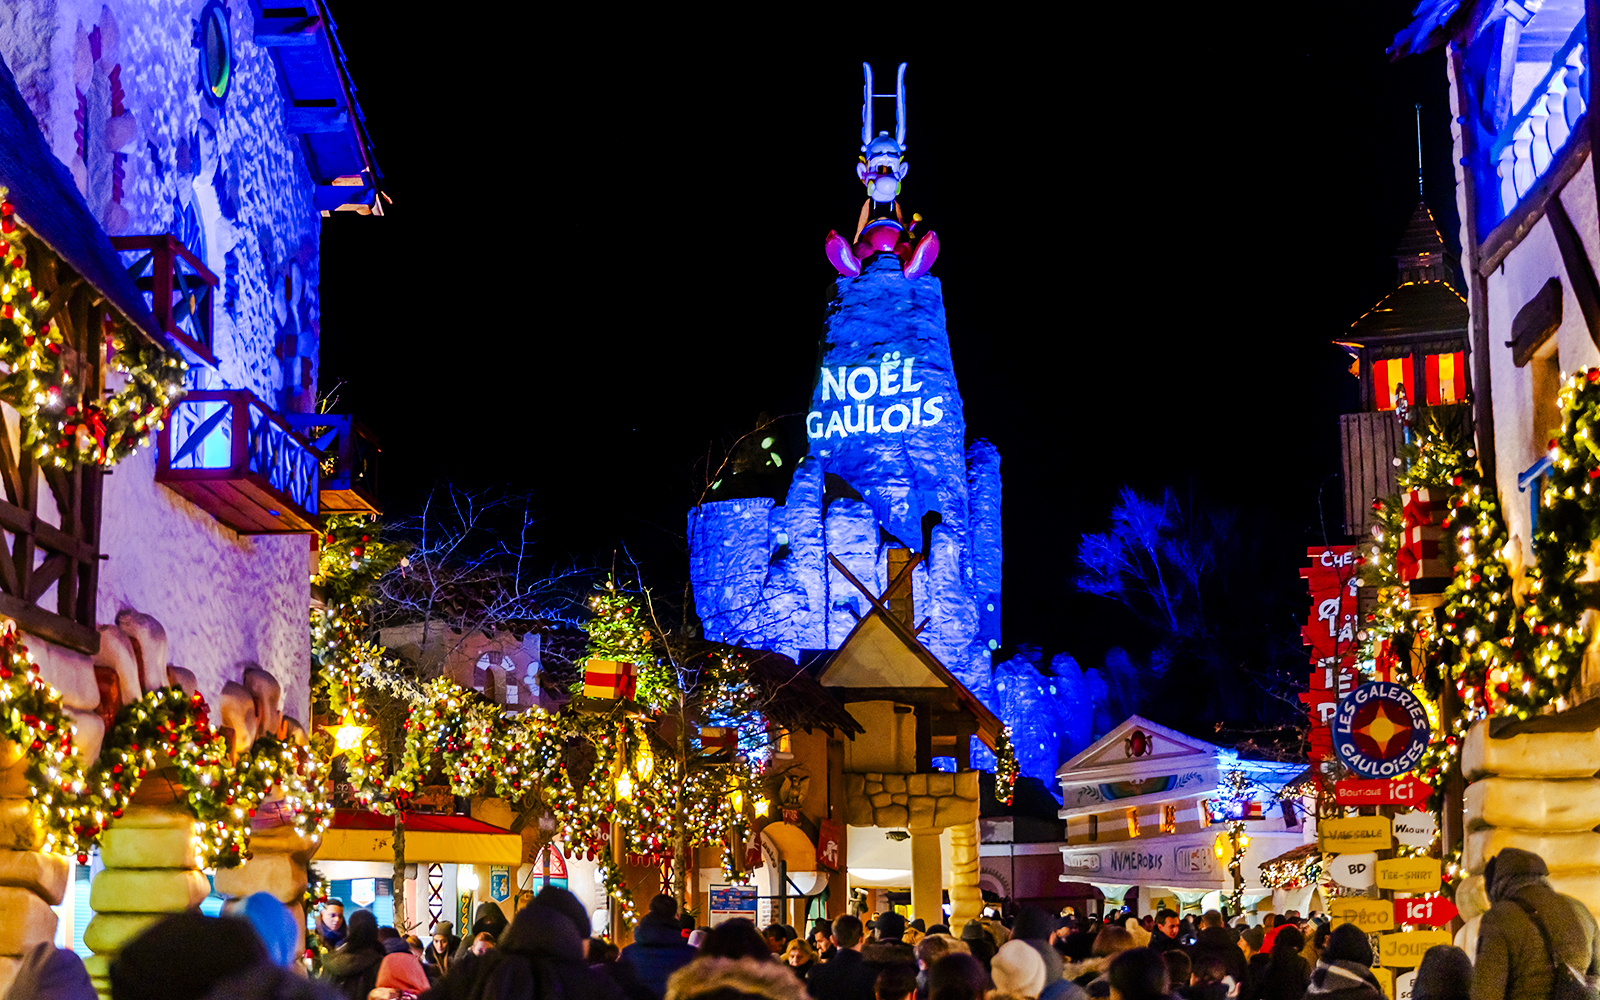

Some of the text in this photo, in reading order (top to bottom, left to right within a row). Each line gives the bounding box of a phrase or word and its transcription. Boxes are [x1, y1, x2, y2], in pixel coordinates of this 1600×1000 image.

[821, 351, 922, 402] NOËL
[806, 396, 944, 440] GAULOIS
[1338, 702, 1356, 733] LES
[1348, 863, 1366, 875] BD
